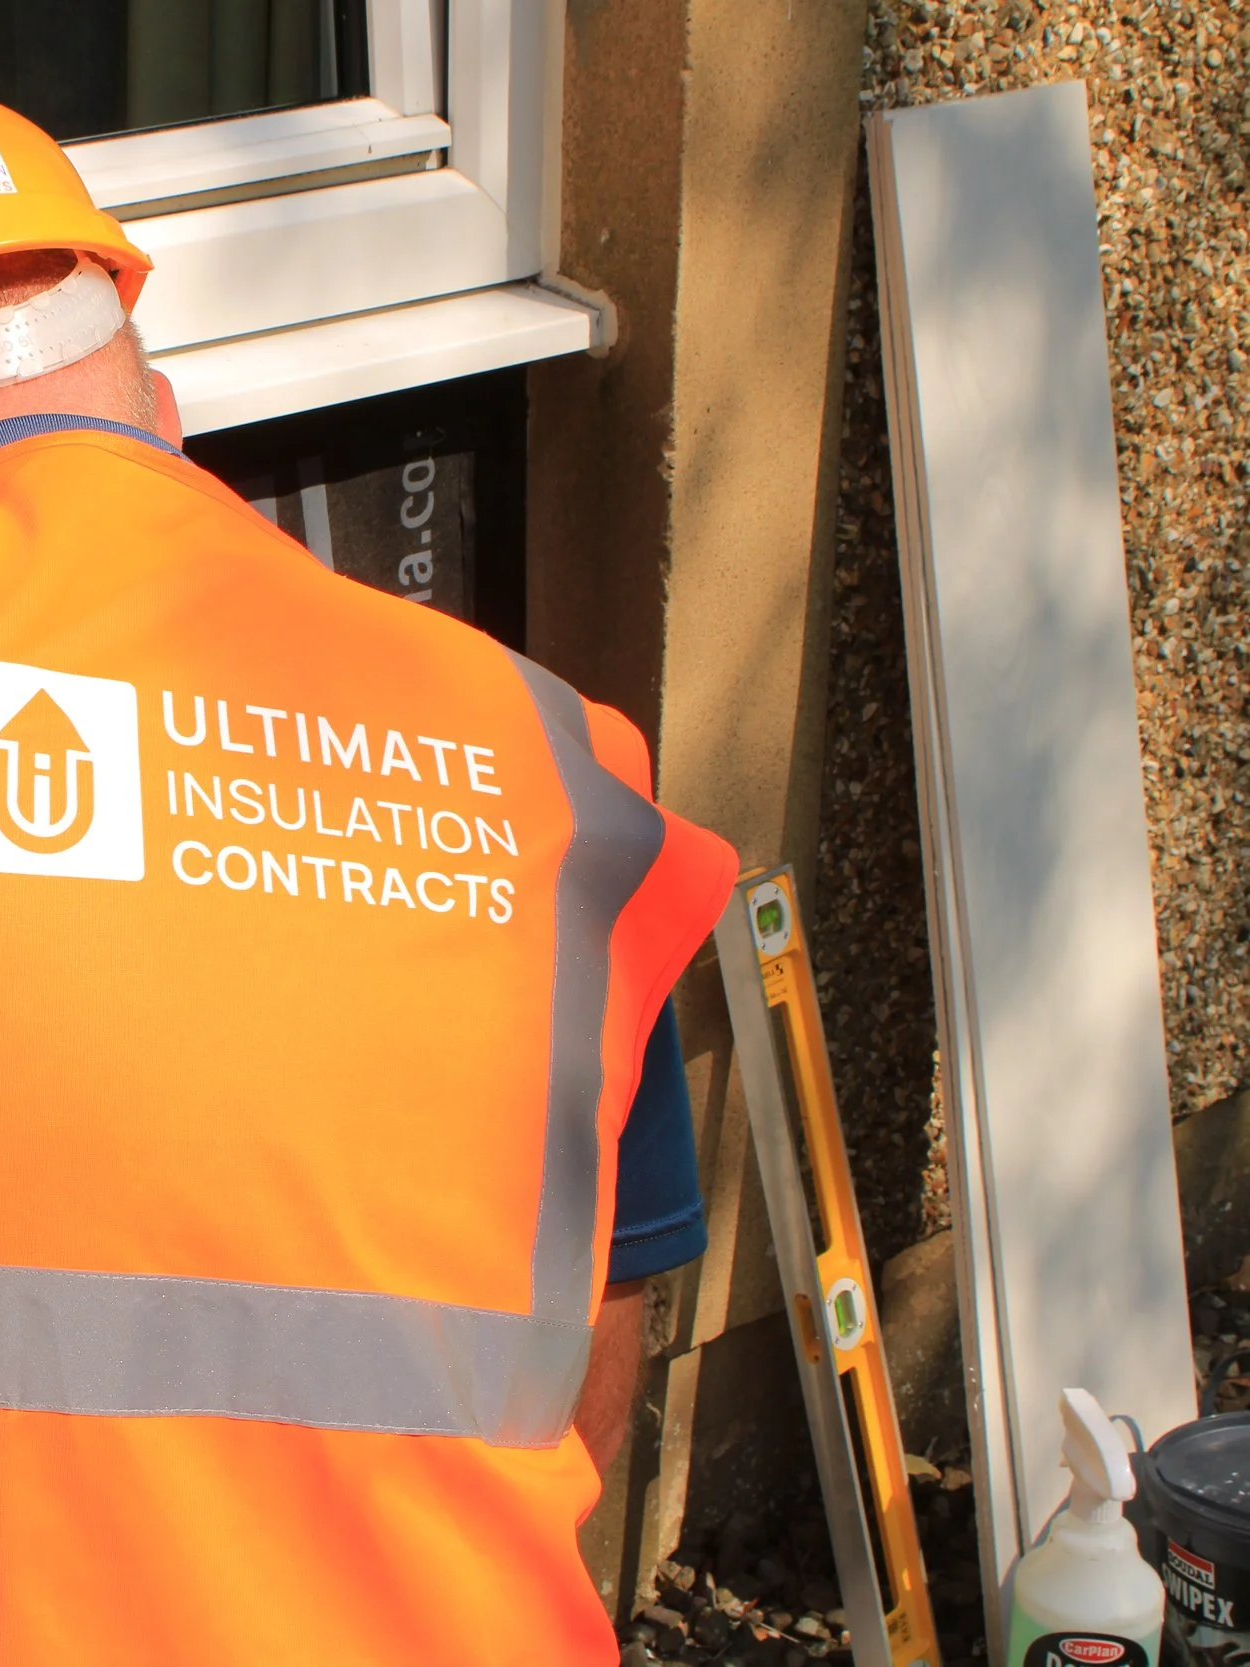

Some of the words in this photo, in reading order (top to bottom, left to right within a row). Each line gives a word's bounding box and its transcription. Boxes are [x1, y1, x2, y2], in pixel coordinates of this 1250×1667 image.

[162, 690, 502, 796] ULTIMATE
[167, 770, 520, 857] INSULATION
[172, 840, 516, 924] CONTRACTS
[1162, 1562, 1234, 1628] SWIPEX
[1065, 1642, 1118, 1657] CarPlan
